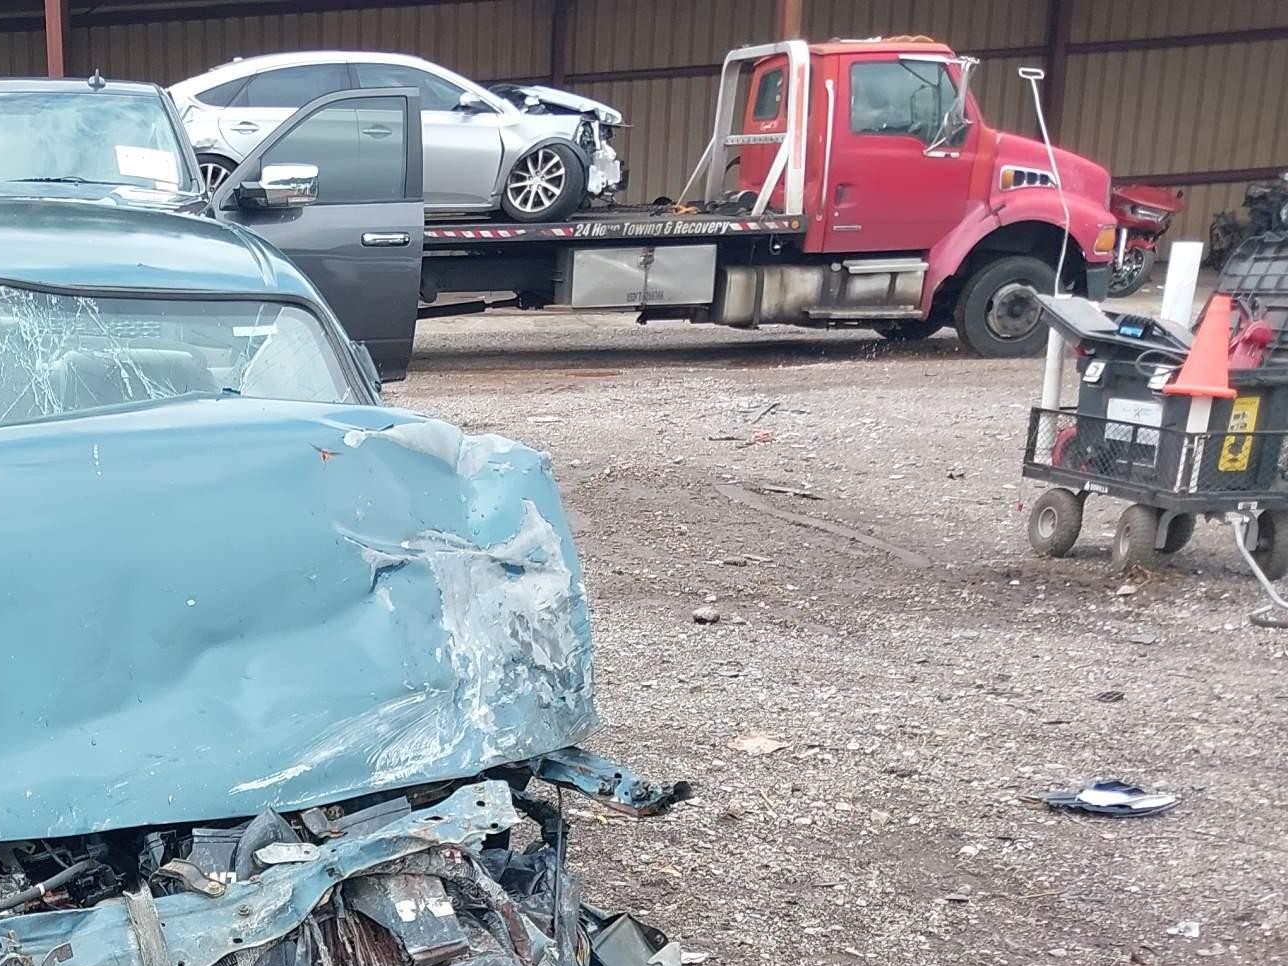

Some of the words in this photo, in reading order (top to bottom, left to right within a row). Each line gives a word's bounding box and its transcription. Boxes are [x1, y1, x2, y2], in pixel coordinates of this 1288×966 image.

[574, 223, 592, 237] 24
[622, 222, 664, 236] Towing
[663, 221, 673, 235] &
[673, 220, 730, 235] Recovery
